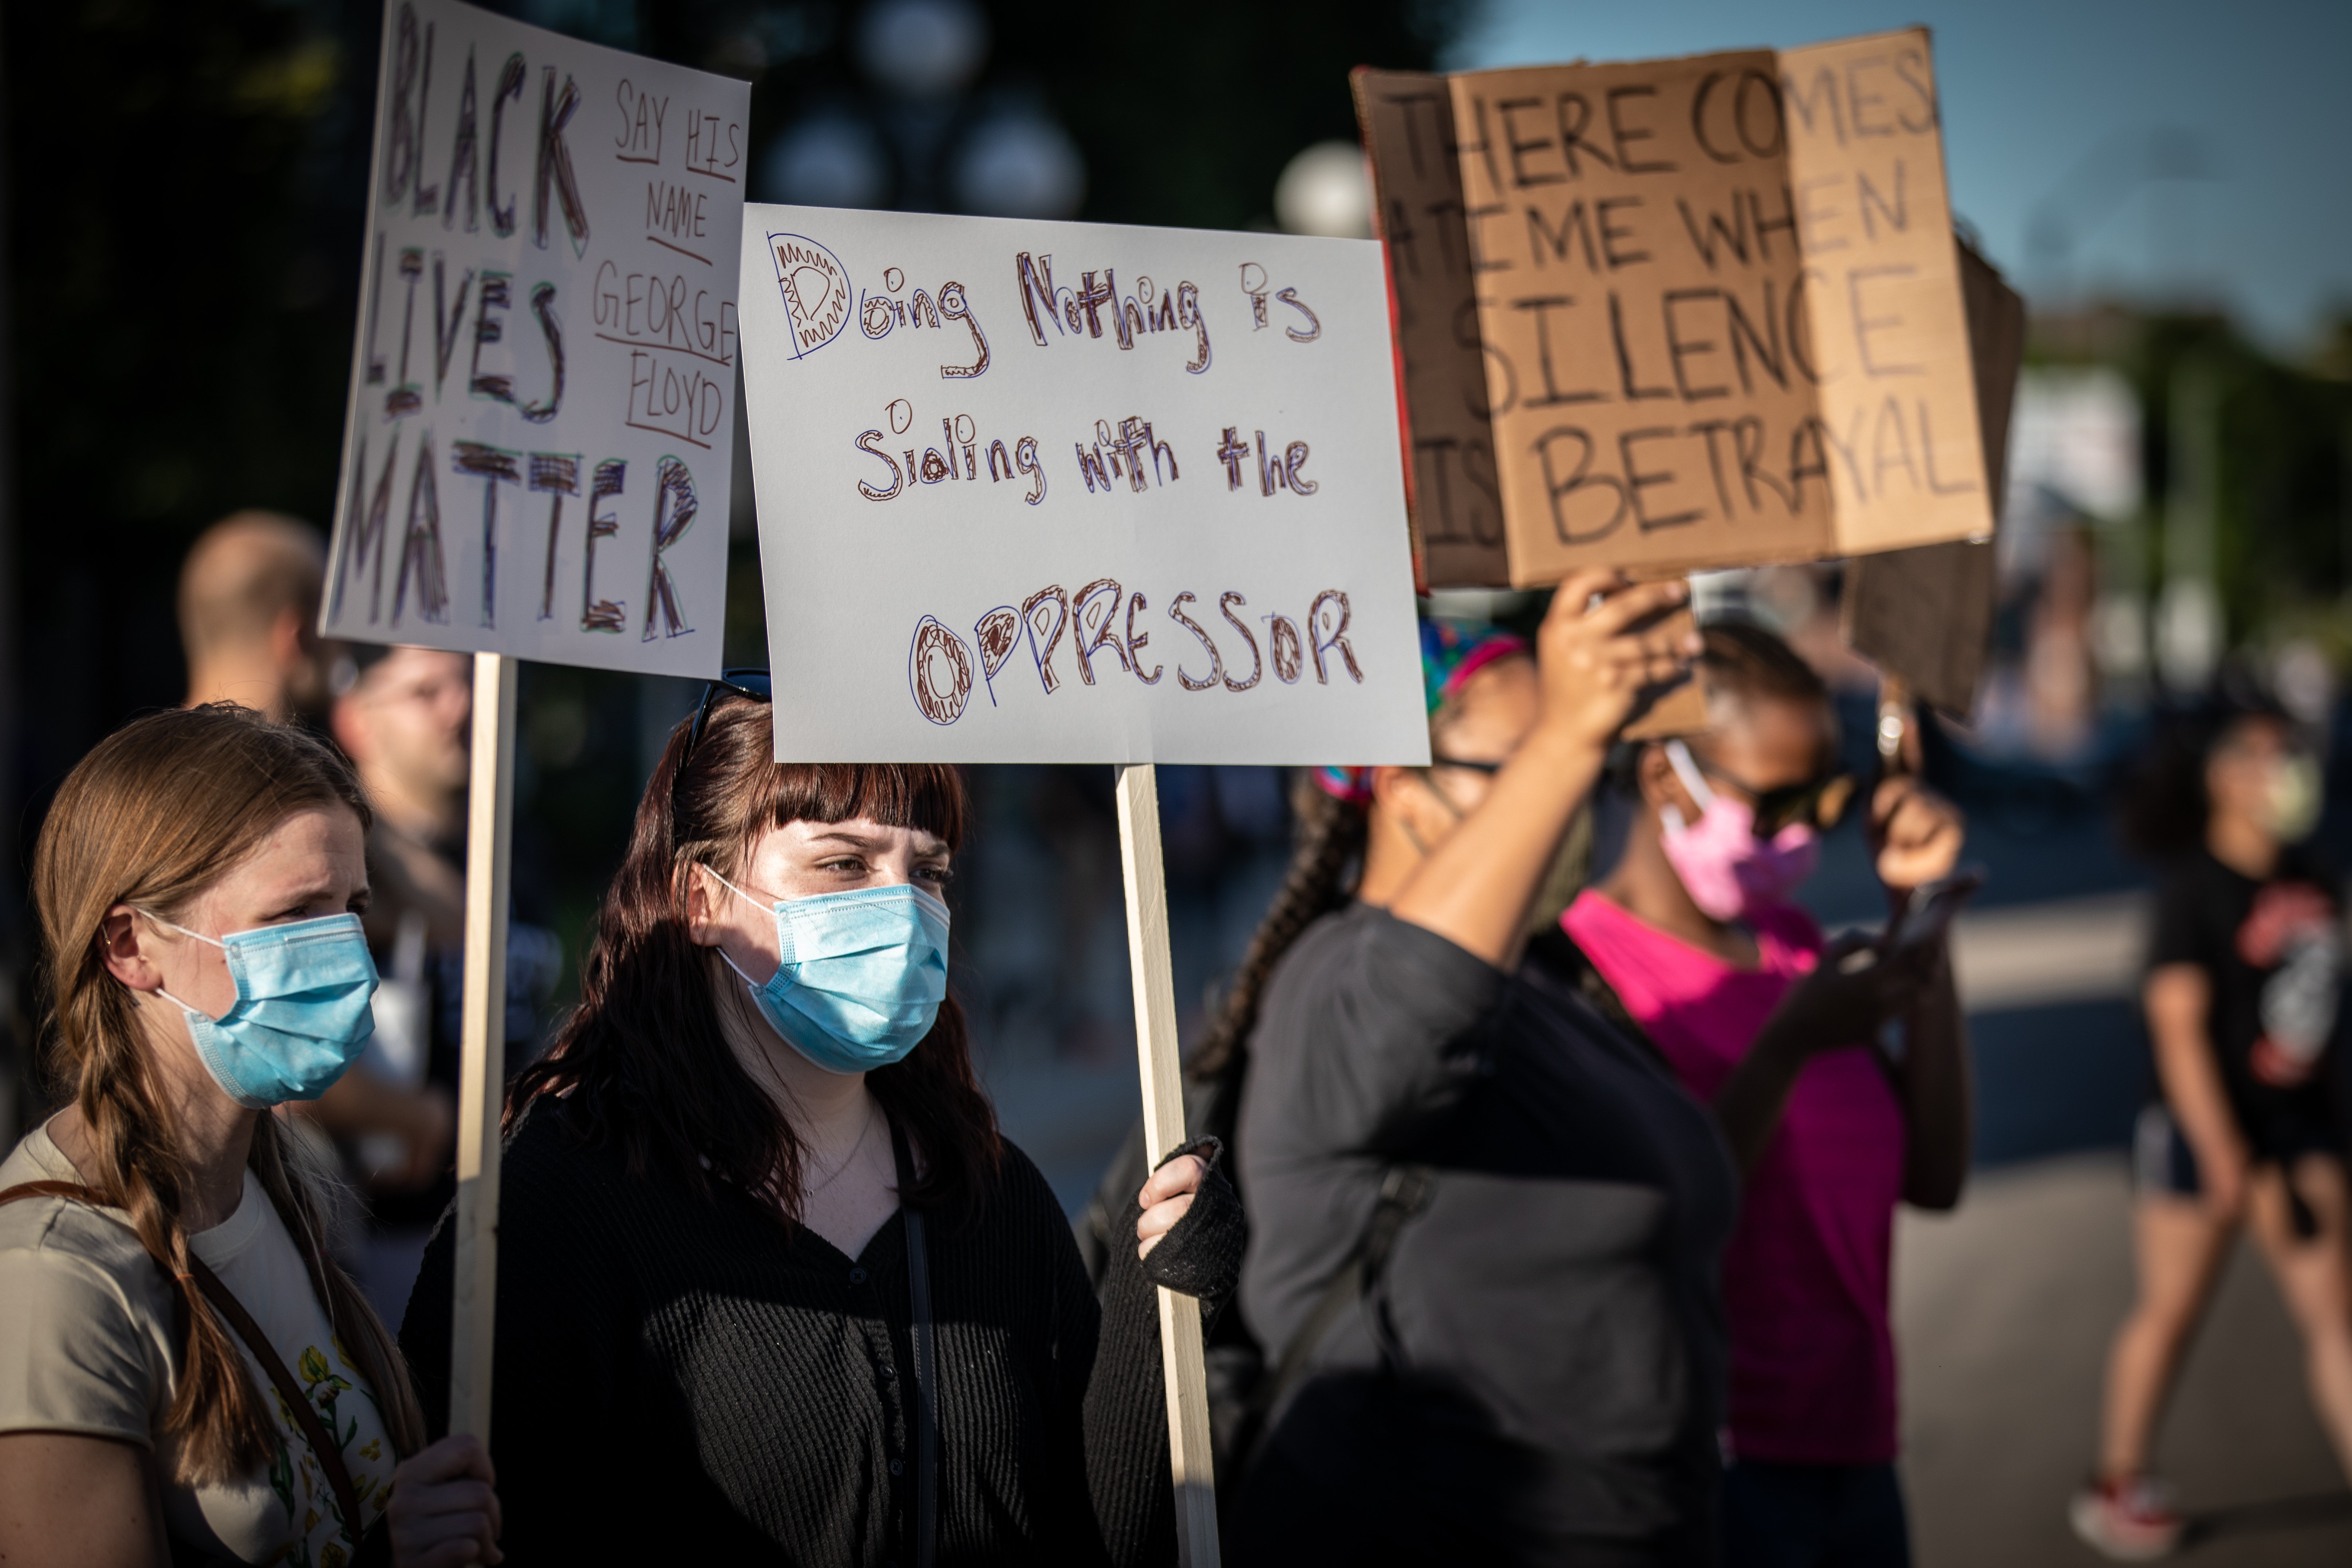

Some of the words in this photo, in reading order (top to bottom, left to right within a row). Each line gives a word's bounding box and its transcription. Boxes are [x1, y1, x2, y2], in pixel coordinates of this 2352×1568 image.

[384, 3, 590, 260] BLACK
[615, 78, 669, 164] SAY
[687, 108, 740, 172] HIS
[1384, 82, 1678, 197] THERE
[1692, 48, 1941, 164] COMES
[647, 180, 707, 238] NAME
[1426, 195, 1655, 275] TIME
[1675, 158, 1910, 271] WHEN
[366, 231, 565, 423] LIVES
[593, 260, 735, 361] GEORGE
[766, 231, 990, 379] Doing
[1015, 251, 1212, 374] Nothing
[1238, 262, 1322, 343] is
[1456, 268, 1930, 420] SILENCE
[627, 349, 722, 439] FLOYD
[855, 399, 1047, 505] Siding
[1076, 415, 1180, 493] with
[1217, 427, 1318, 497] the
[331, 420, 698, 643] MATTER
[1416, 437, 1500, 546] IS
[1529, 393, 1979, 546] BETRAYAL
[909, 578, 1365, 726] OPPRESSOR
